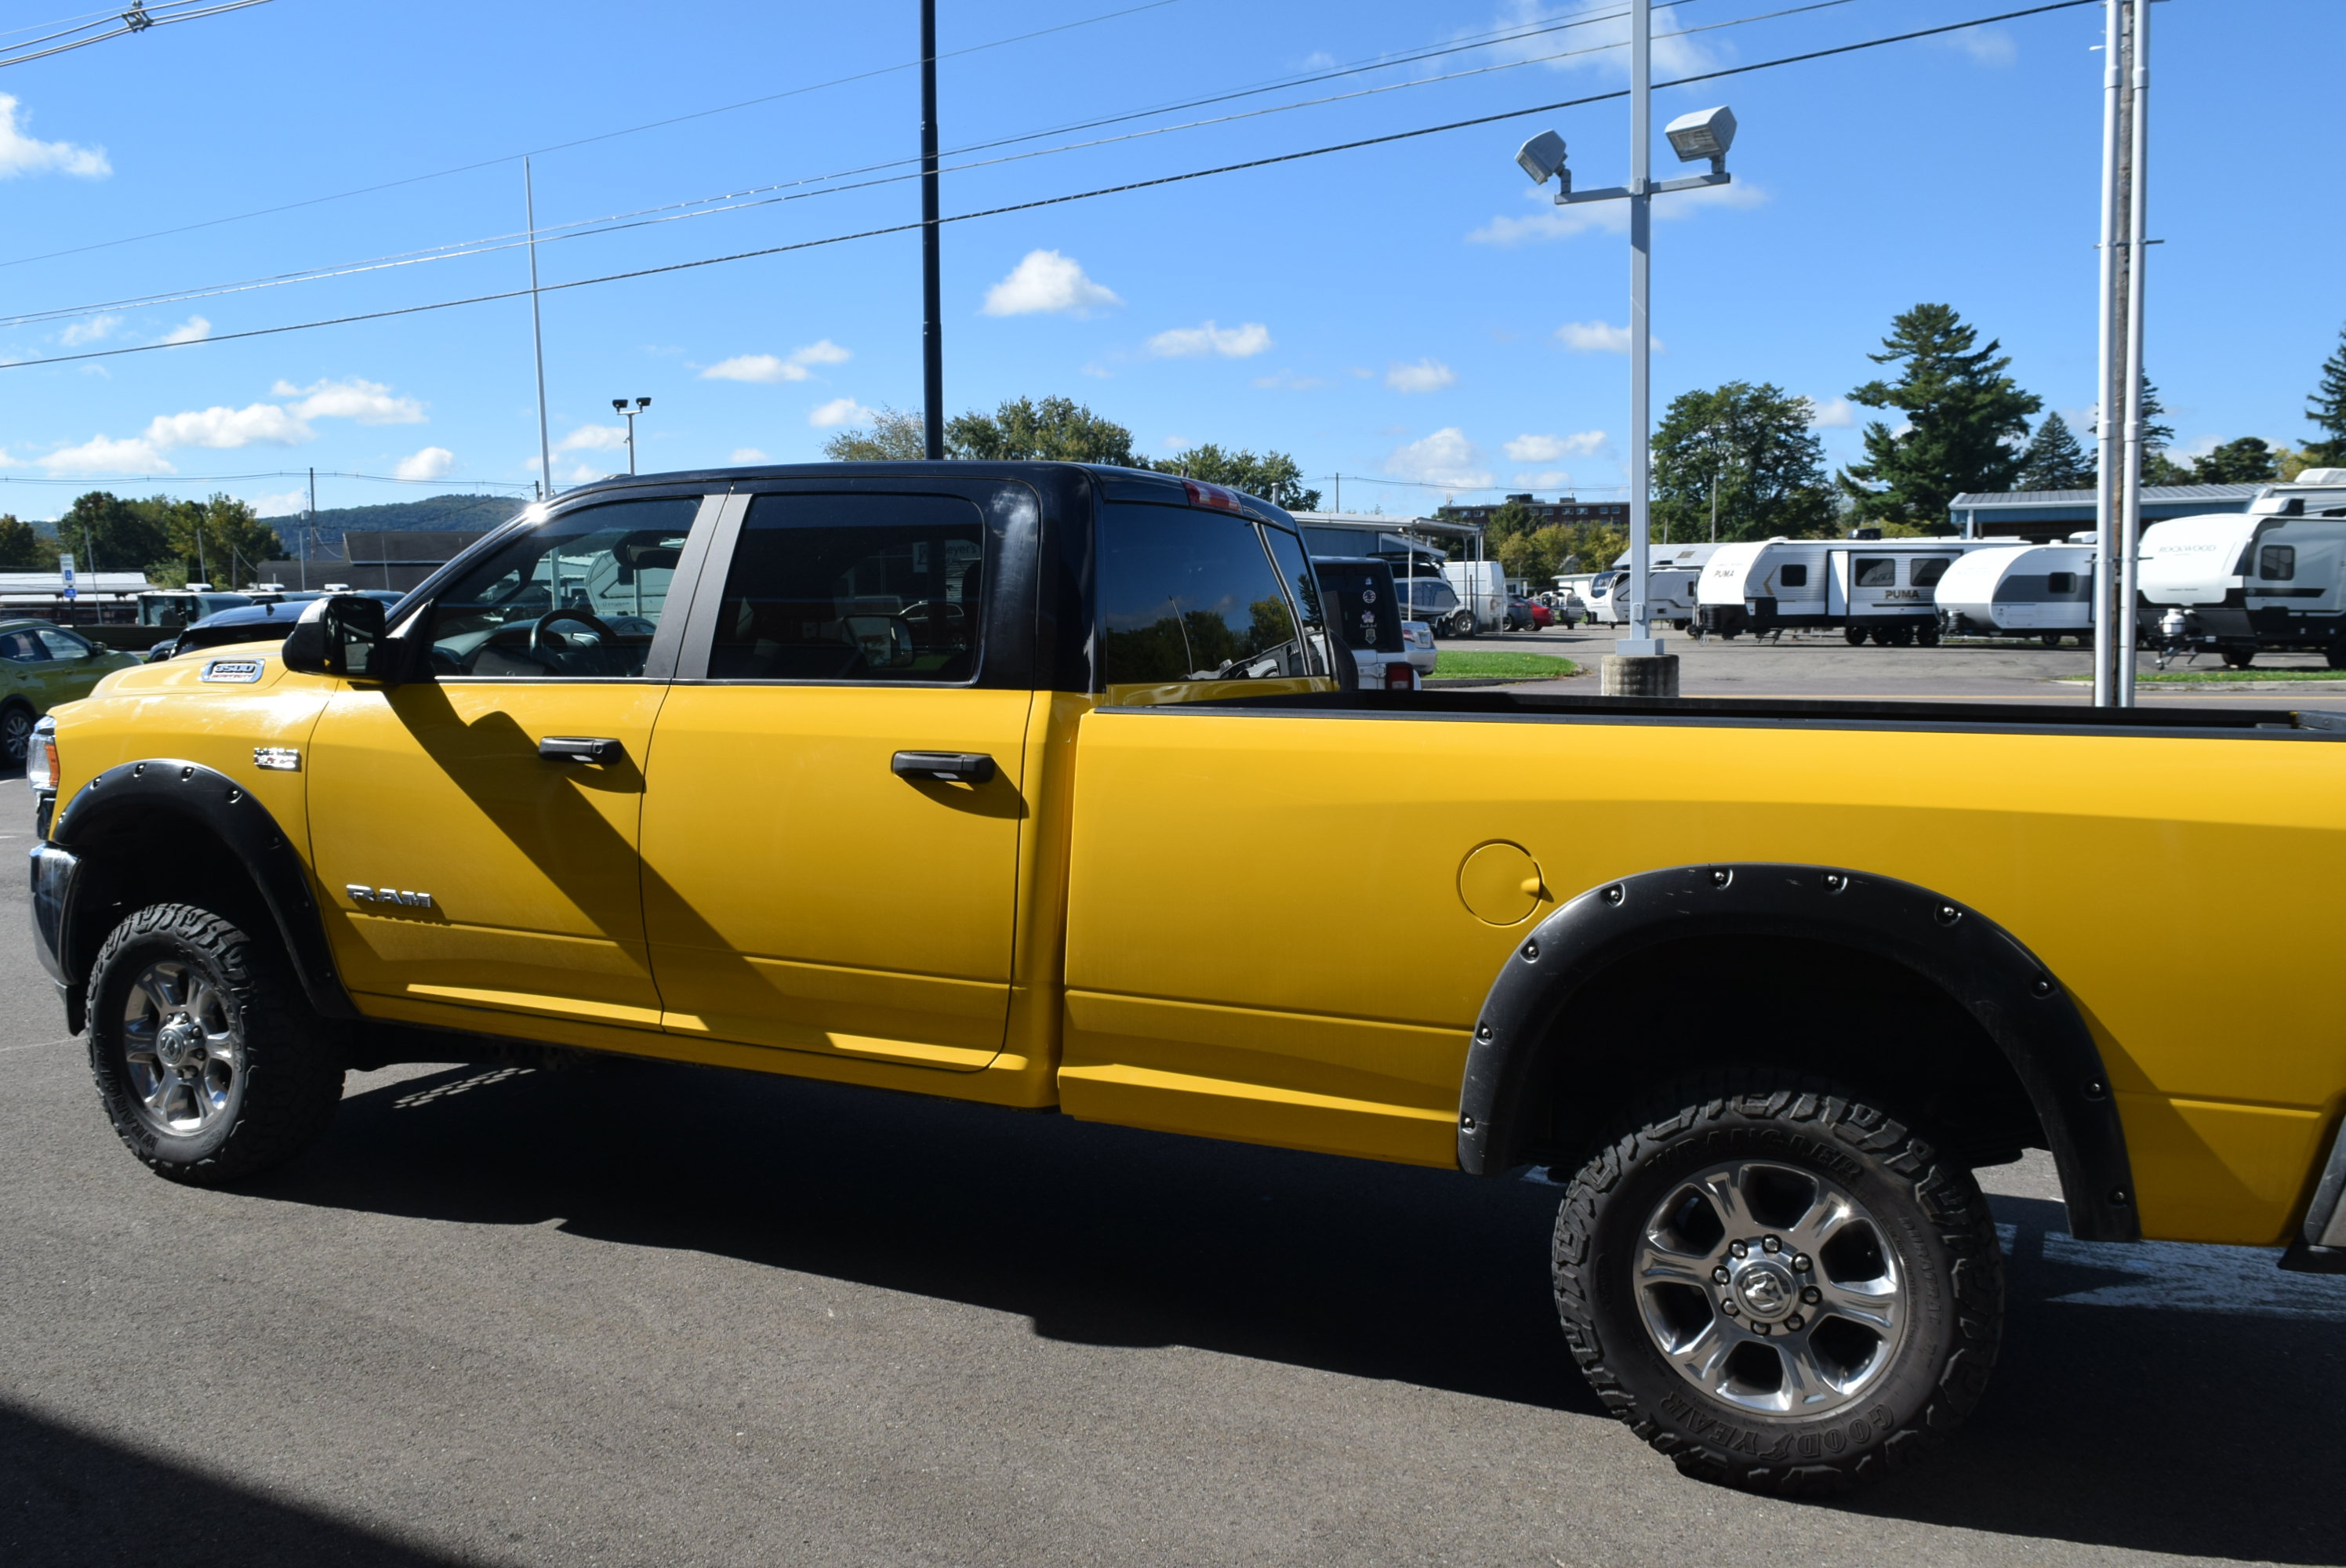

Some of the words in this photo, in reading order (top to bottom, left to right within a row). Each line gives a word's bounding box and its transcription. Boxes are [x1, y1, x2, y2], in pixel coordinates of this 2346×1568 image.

[1714, 569, 1734, 579] PUMA
[1884, 590, 1920, 600] PUMA
[215, 664, 256, 673] 3500
[346, 884, 431, 908] RAM
